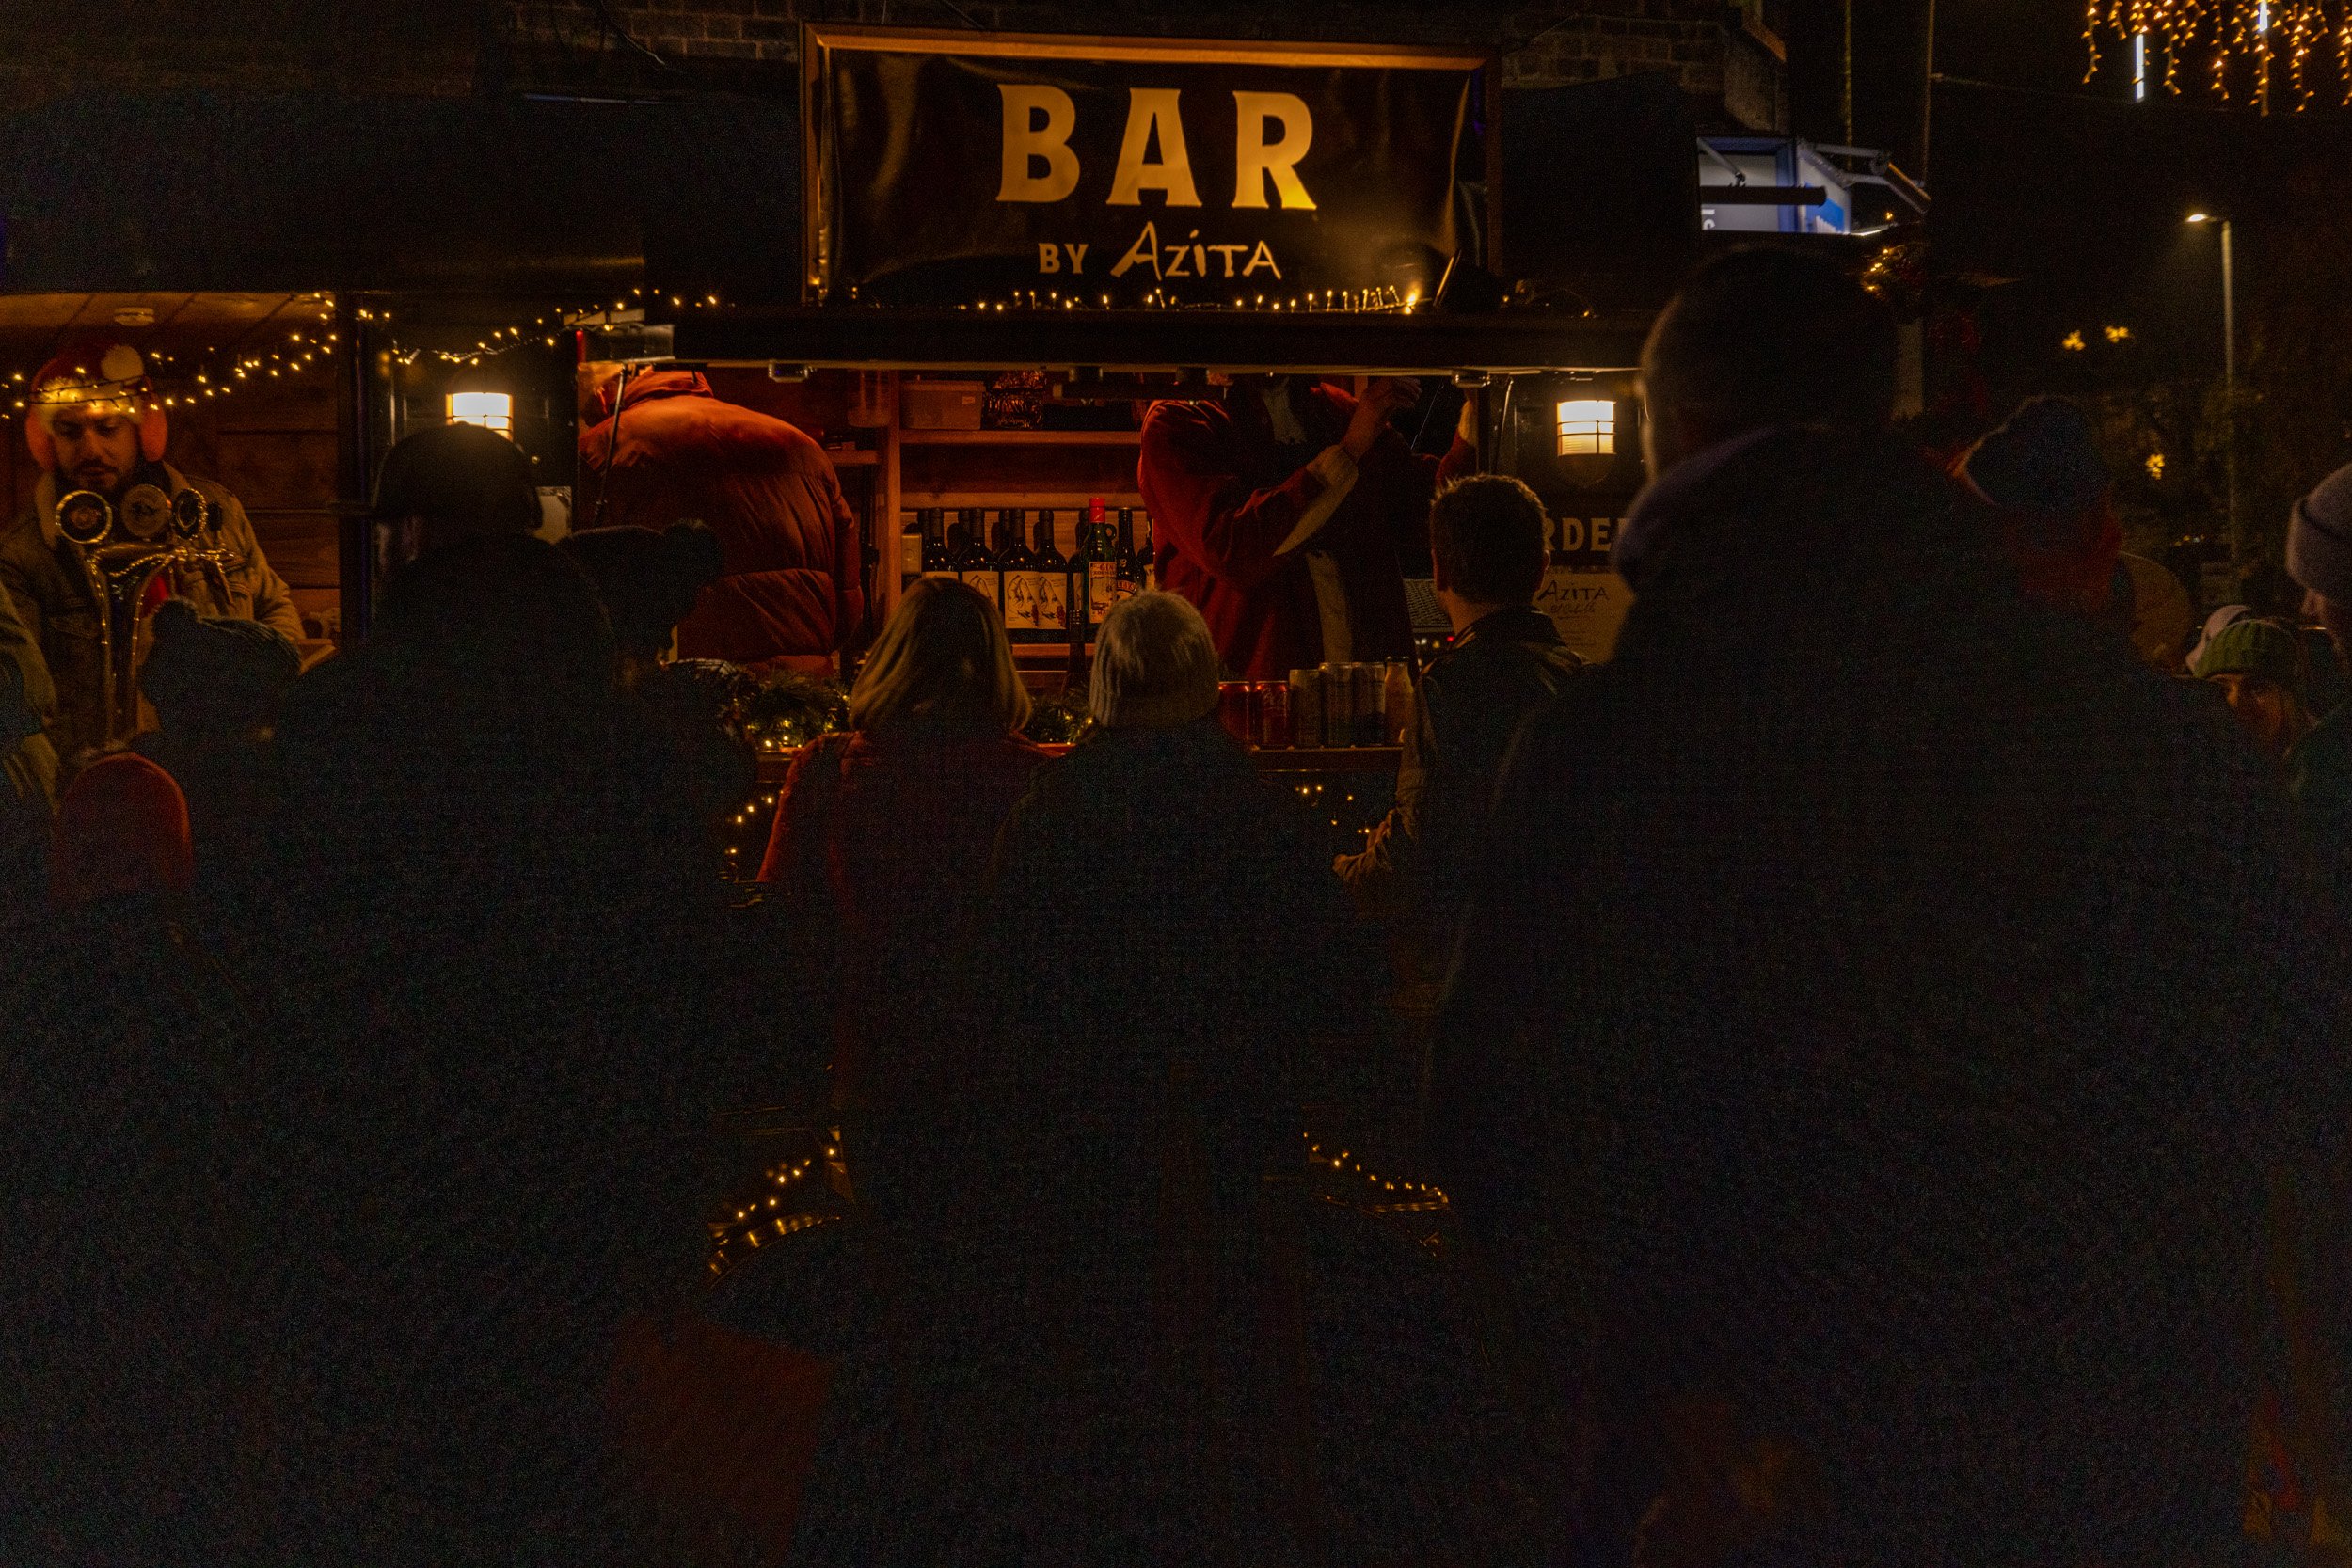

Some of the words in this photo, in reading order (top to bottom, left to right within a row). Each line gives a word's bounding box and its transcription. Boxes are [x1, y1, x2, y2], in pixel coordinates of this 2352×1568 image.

[995, 83, 1317, 210] BAR
[1039, 243, 1089, 275] BY
[1543, 517, 1628, 551] RDE
